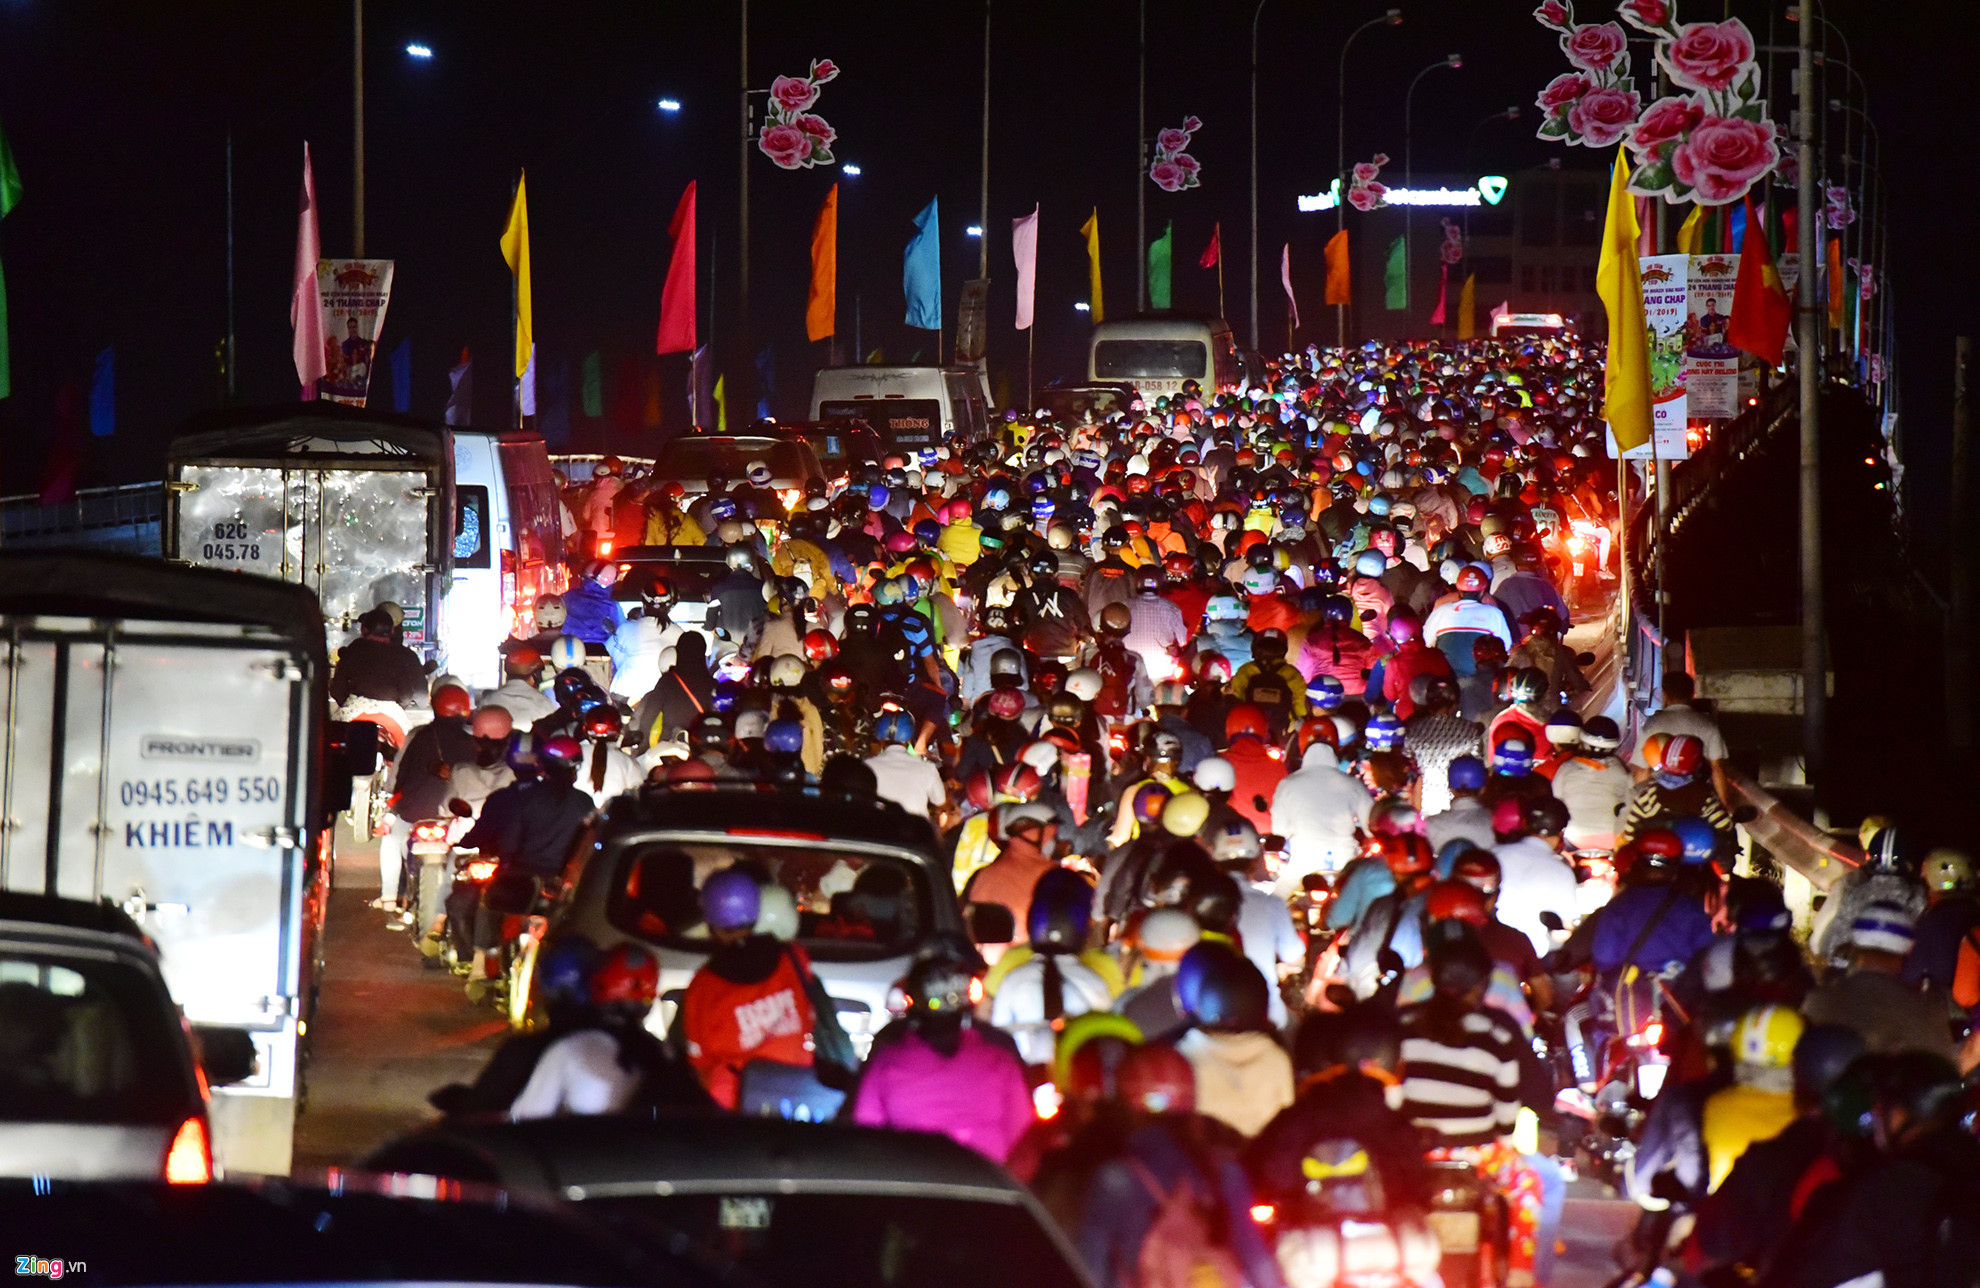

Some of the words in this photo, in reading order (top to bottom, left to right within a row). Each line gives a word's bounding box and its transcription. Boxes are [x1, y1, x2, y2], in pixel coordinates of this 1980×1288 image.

[1166, 381, 1178, 390] 12
[889, 417, 930, 429] THÔNG
[214, 523, 247, 539] 62C
[203, 544, 260, 560] 045.78
[148, 742, 253, 756] FRONTIER
[121, 780, 229, 806] 0945.649
[238, 777, 280, 803] 550
[126, 813, 234, 848] KHIÊM
